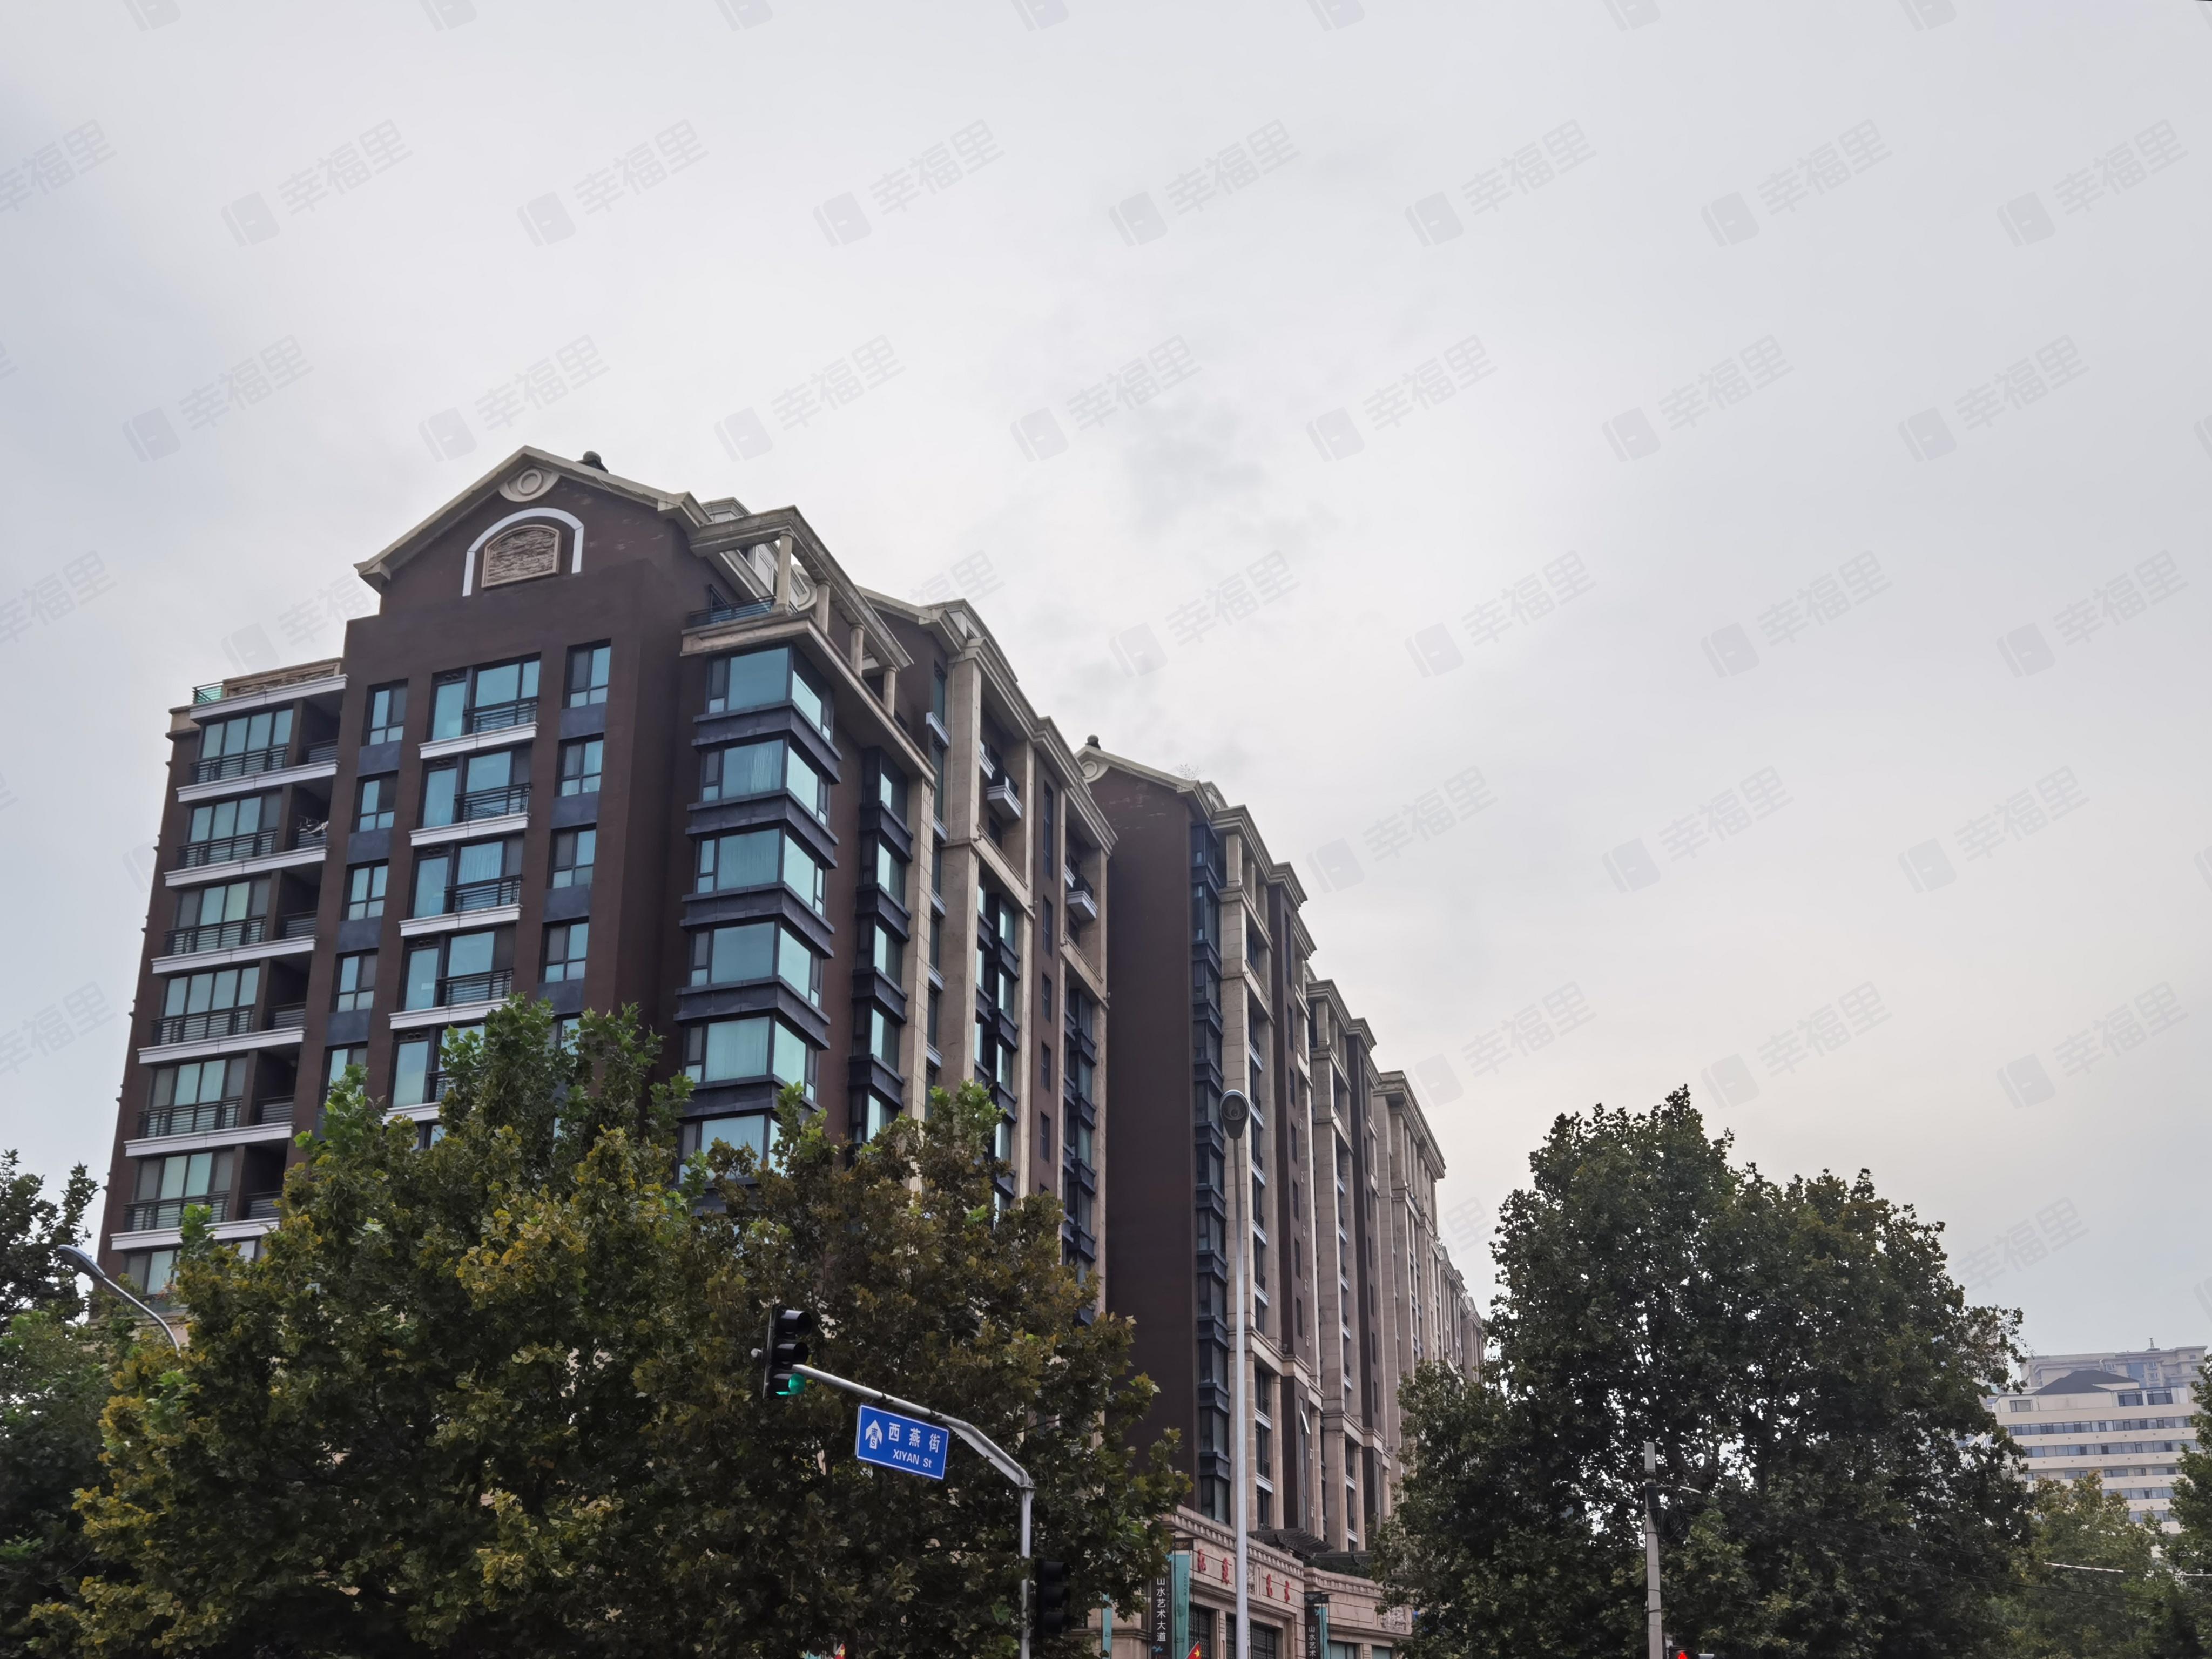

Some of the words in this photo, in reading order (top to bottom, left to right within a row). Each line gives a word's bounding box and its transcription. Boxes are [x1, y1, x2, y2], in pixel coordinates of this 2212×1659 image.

[888, 1422, 941, 1453] 西燕街
[892, 1448, 920, 1465] XIYAN
[923, 1457, 932, 1468] St
[1156, 1577, 1166, 1642] 山水艺术大道
[1308, 1625, 1317, 1659] 山水艺术
